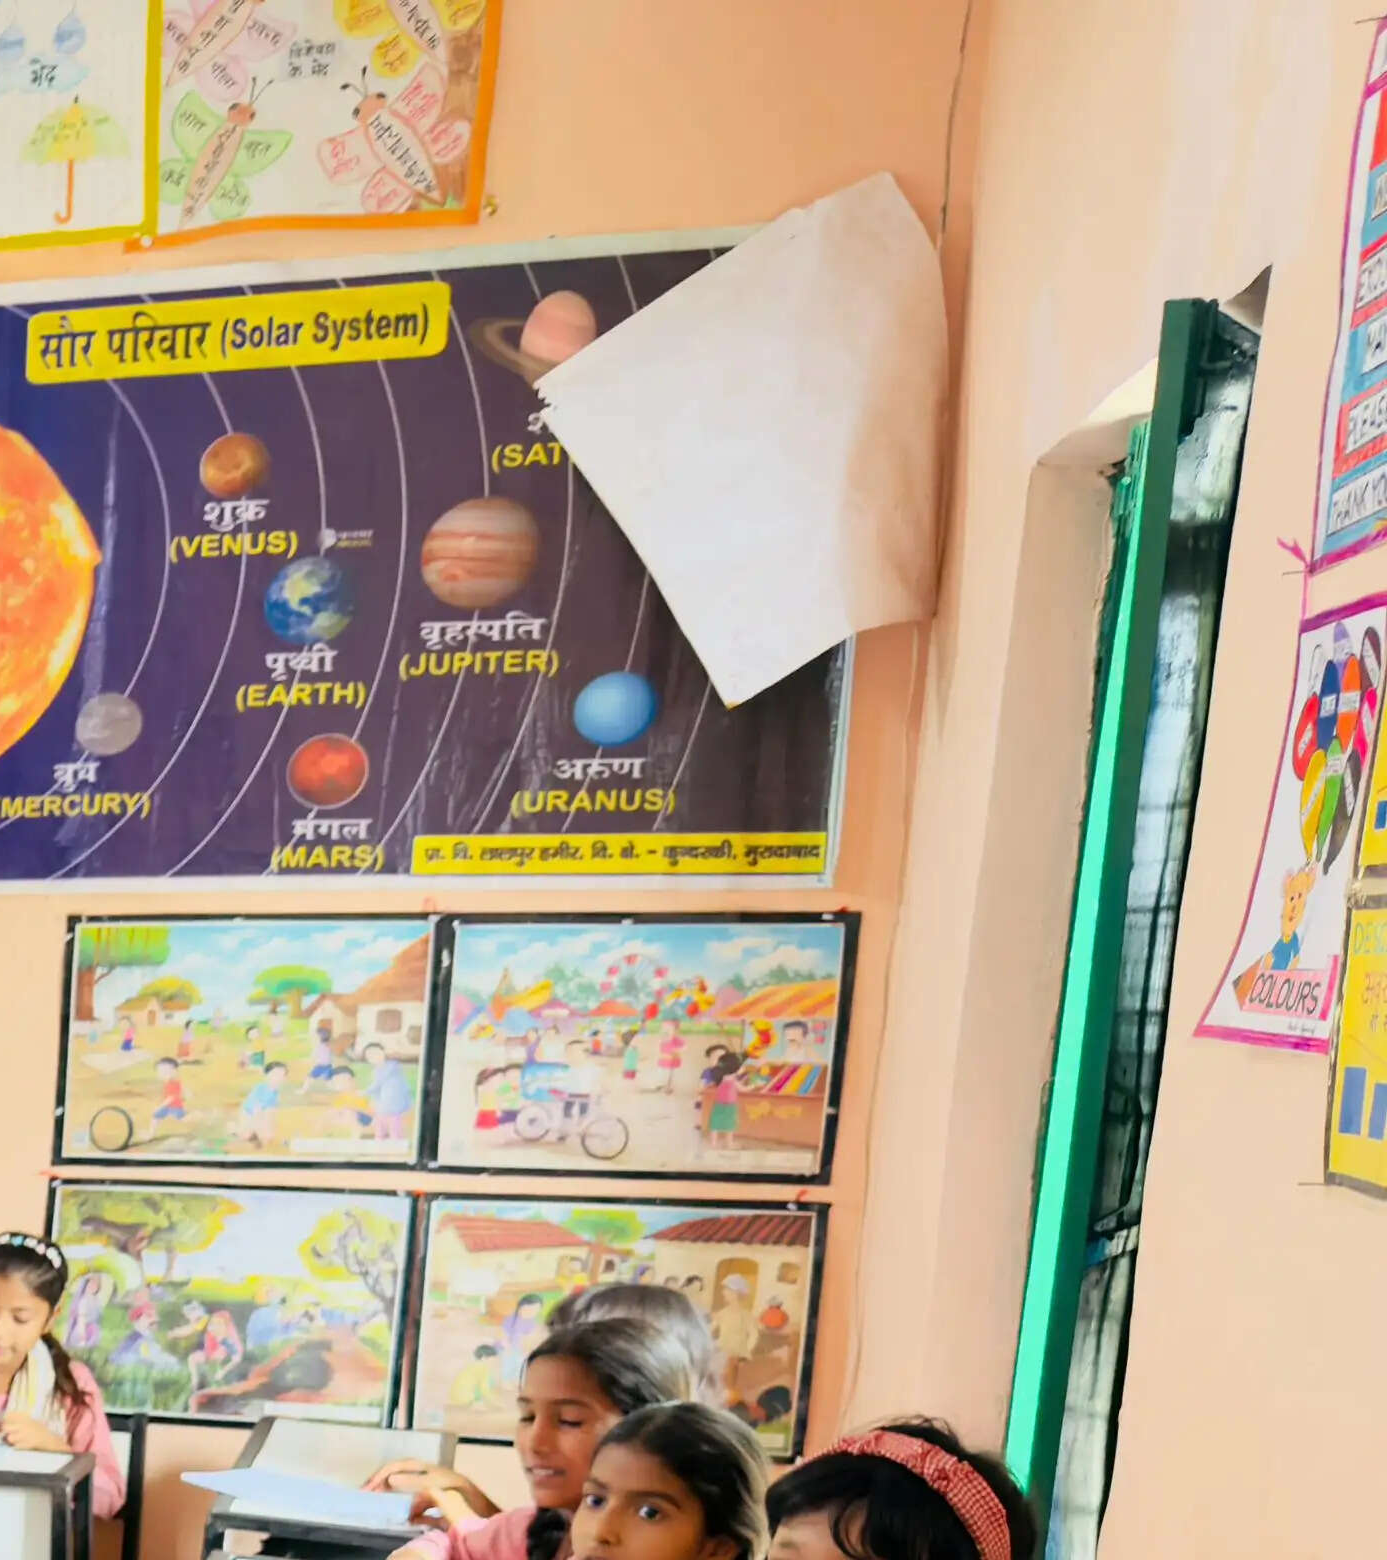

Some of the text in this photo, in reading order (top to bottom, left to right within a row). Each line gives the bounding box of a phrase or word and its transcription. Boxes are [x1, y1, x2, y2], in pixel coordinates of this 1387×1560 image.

[39, 304, 430, 369] सौर परिवार (Solar System)
[492, 441, 564, 473] (SAT
[203, 498, 270, 533] शुक्र
[170, 530, 298, 563] (VENUS)
[420, 609, 547, 650] वृहस्पति
[265, 642, 338, 681] पृथ्वी
[399, 649, 559, 681] (JUPITER)
[235, 681, 366, 712] (EARTH)
[553, 756, 646, 781] अरुण
[510, 788, 676, 817] (URANUS)
[292, 813, 373, 841] मंगल
[270, 843, 385, 872] (MARS)
[1248, 972, 1322, 1015] COLOURS
